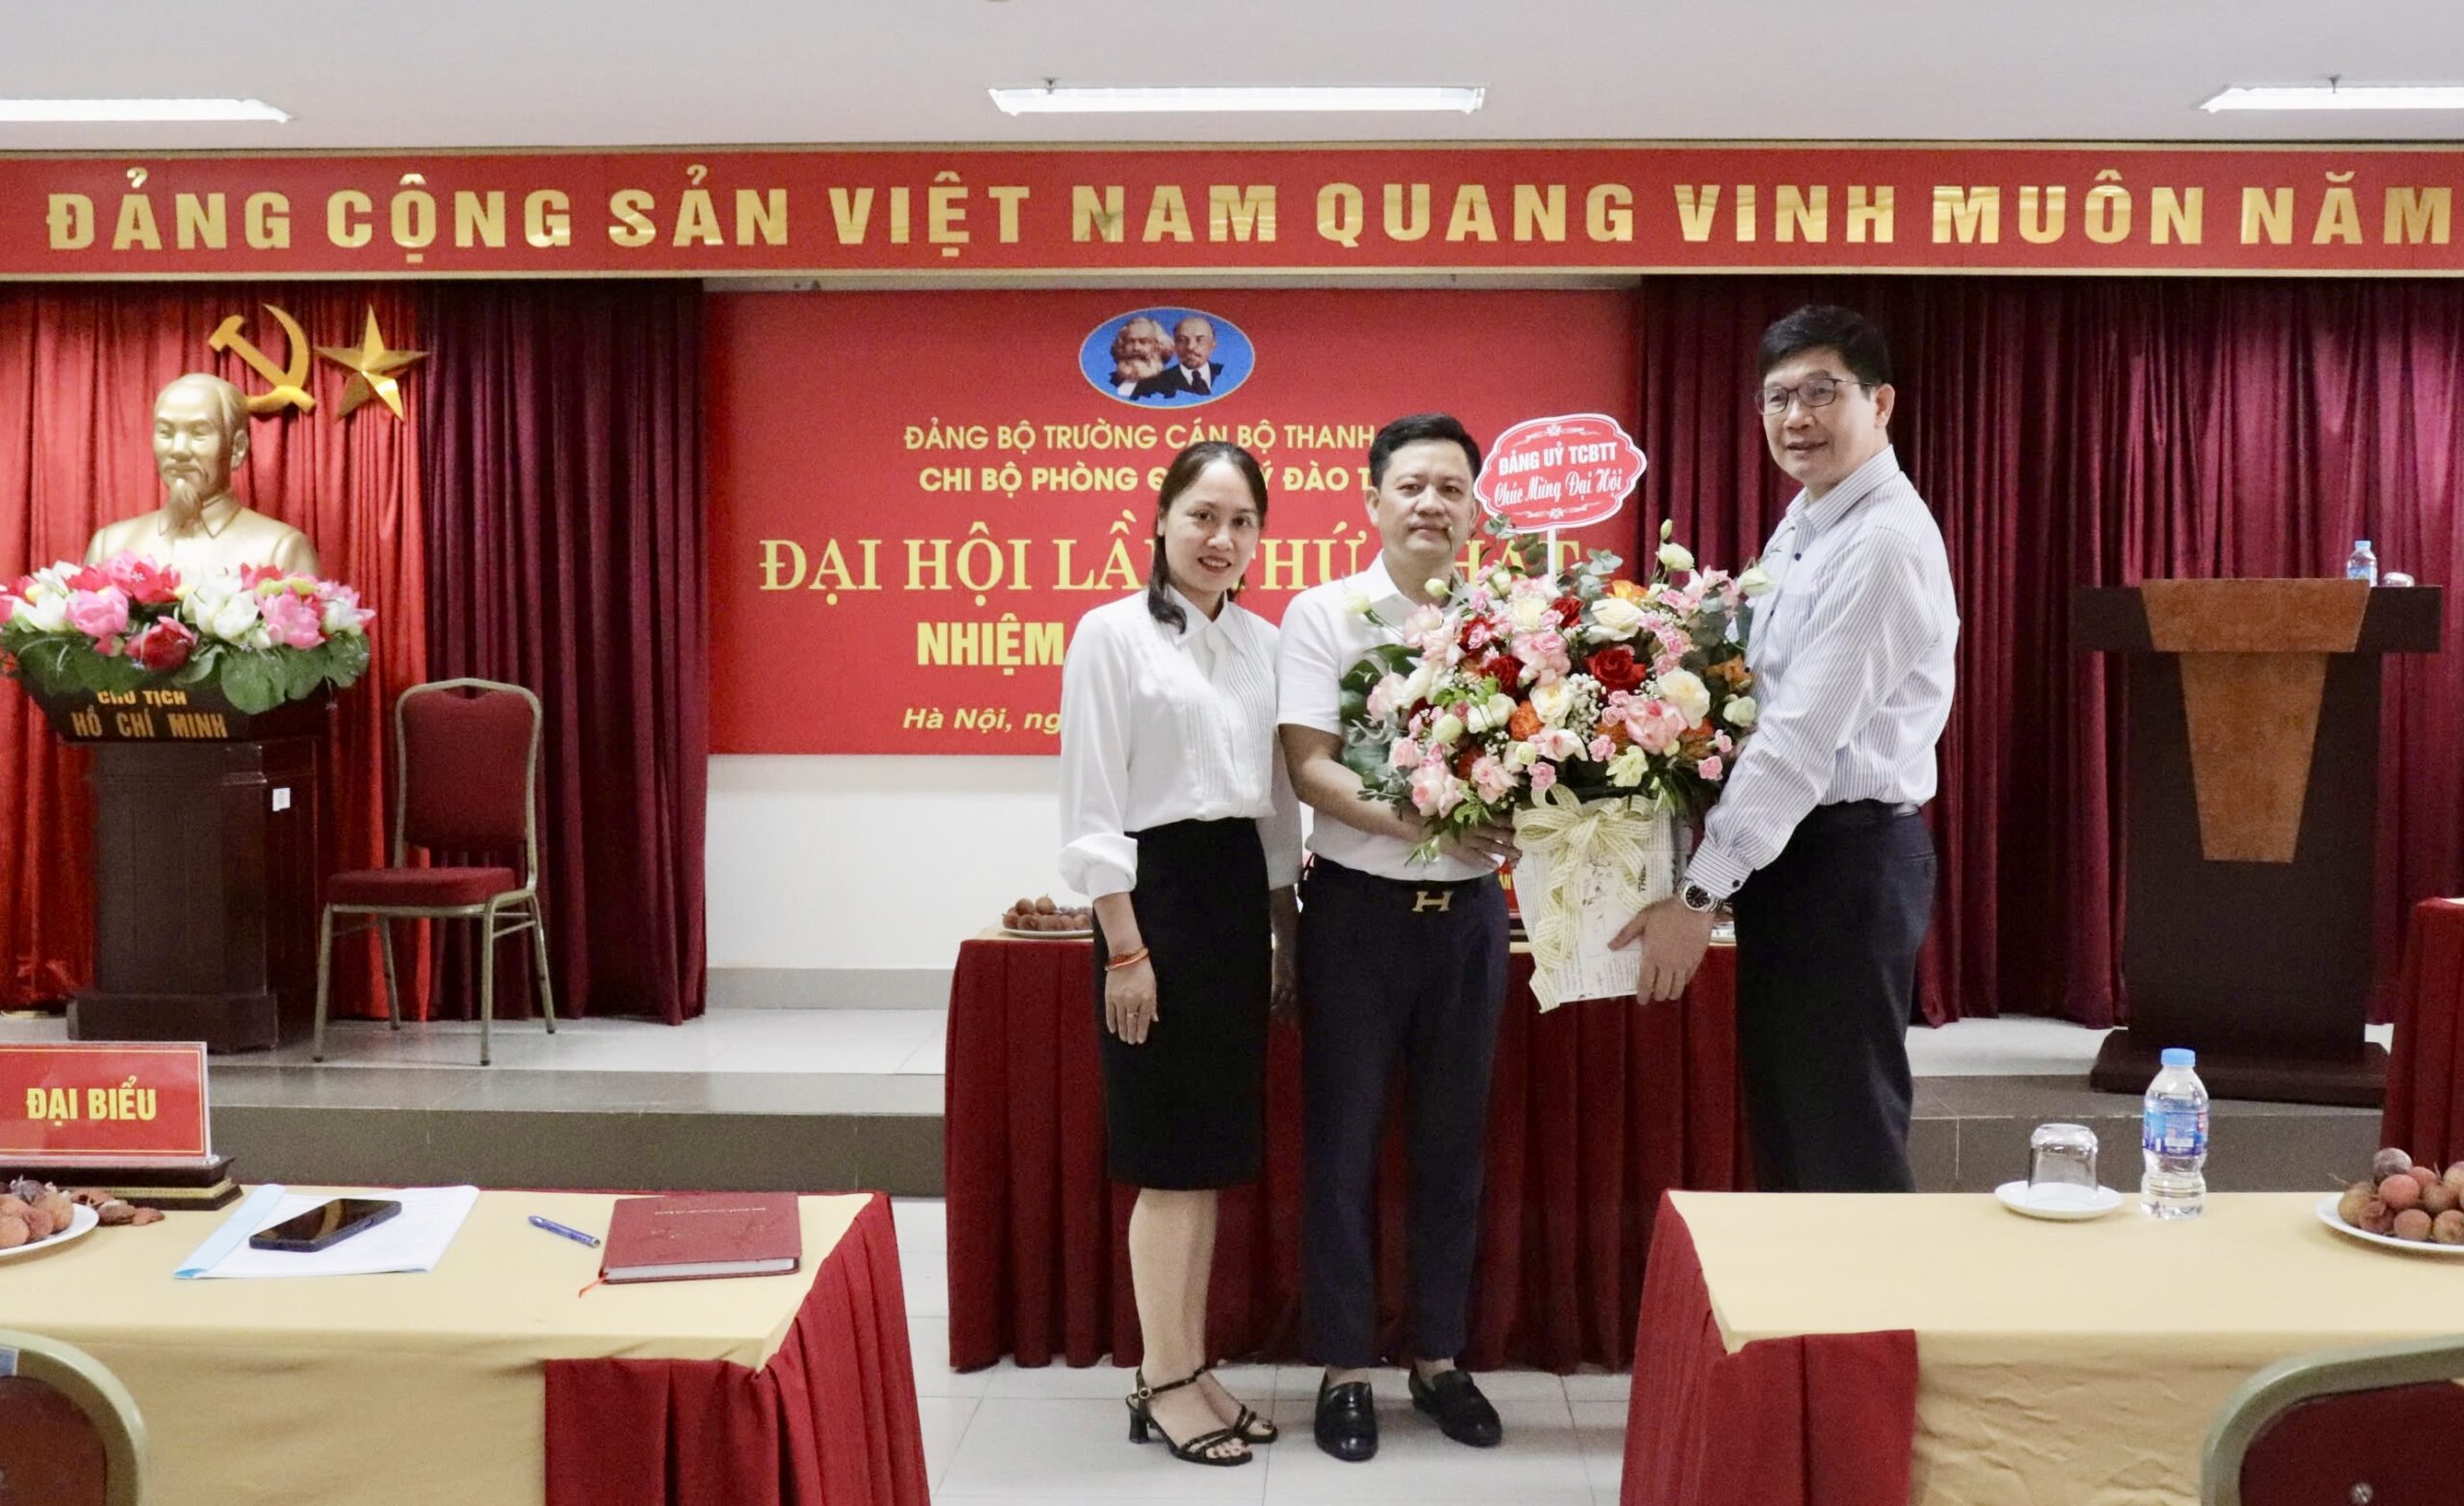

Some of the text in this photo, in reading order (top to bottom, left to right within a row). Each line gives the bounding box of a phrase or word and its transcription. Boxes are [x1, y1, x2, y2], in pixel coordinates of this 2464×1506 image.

[45, 165, 2451, 264] ĐẢNG CỘNG SẢN VIỆT NAM QUANG VINH MUÔN NĂM
[904, 417, 1375, 455] ĐẢNG BỘ TRƯỜNG CÁN BỘ THANH
[1499, 449, 1540, 476] ĐẢNG
[1568, 442, 1618, 464] TCBTT
[919, 467, 971, 492] CHI
[981, 461, 1023, 498] BỘ
[1032, 460, 1139, 492] PHÒNG
[1282, 460, 1349, 492] ĐÀO
[759, 538, 883, 606] ĐẠI
[903, 521, 1033, 607] HỘI
[1245, 521, 1369, 591] HỨ
[917, 612, 1064, 676] NHIỆM
[167, 712, 229, 738] MINH
[903, 707, 944, 729] Hà
[953, 707, 1014, 735] Nội,
[26, 1074, 158, 1127] ĐẠI BIỂU
